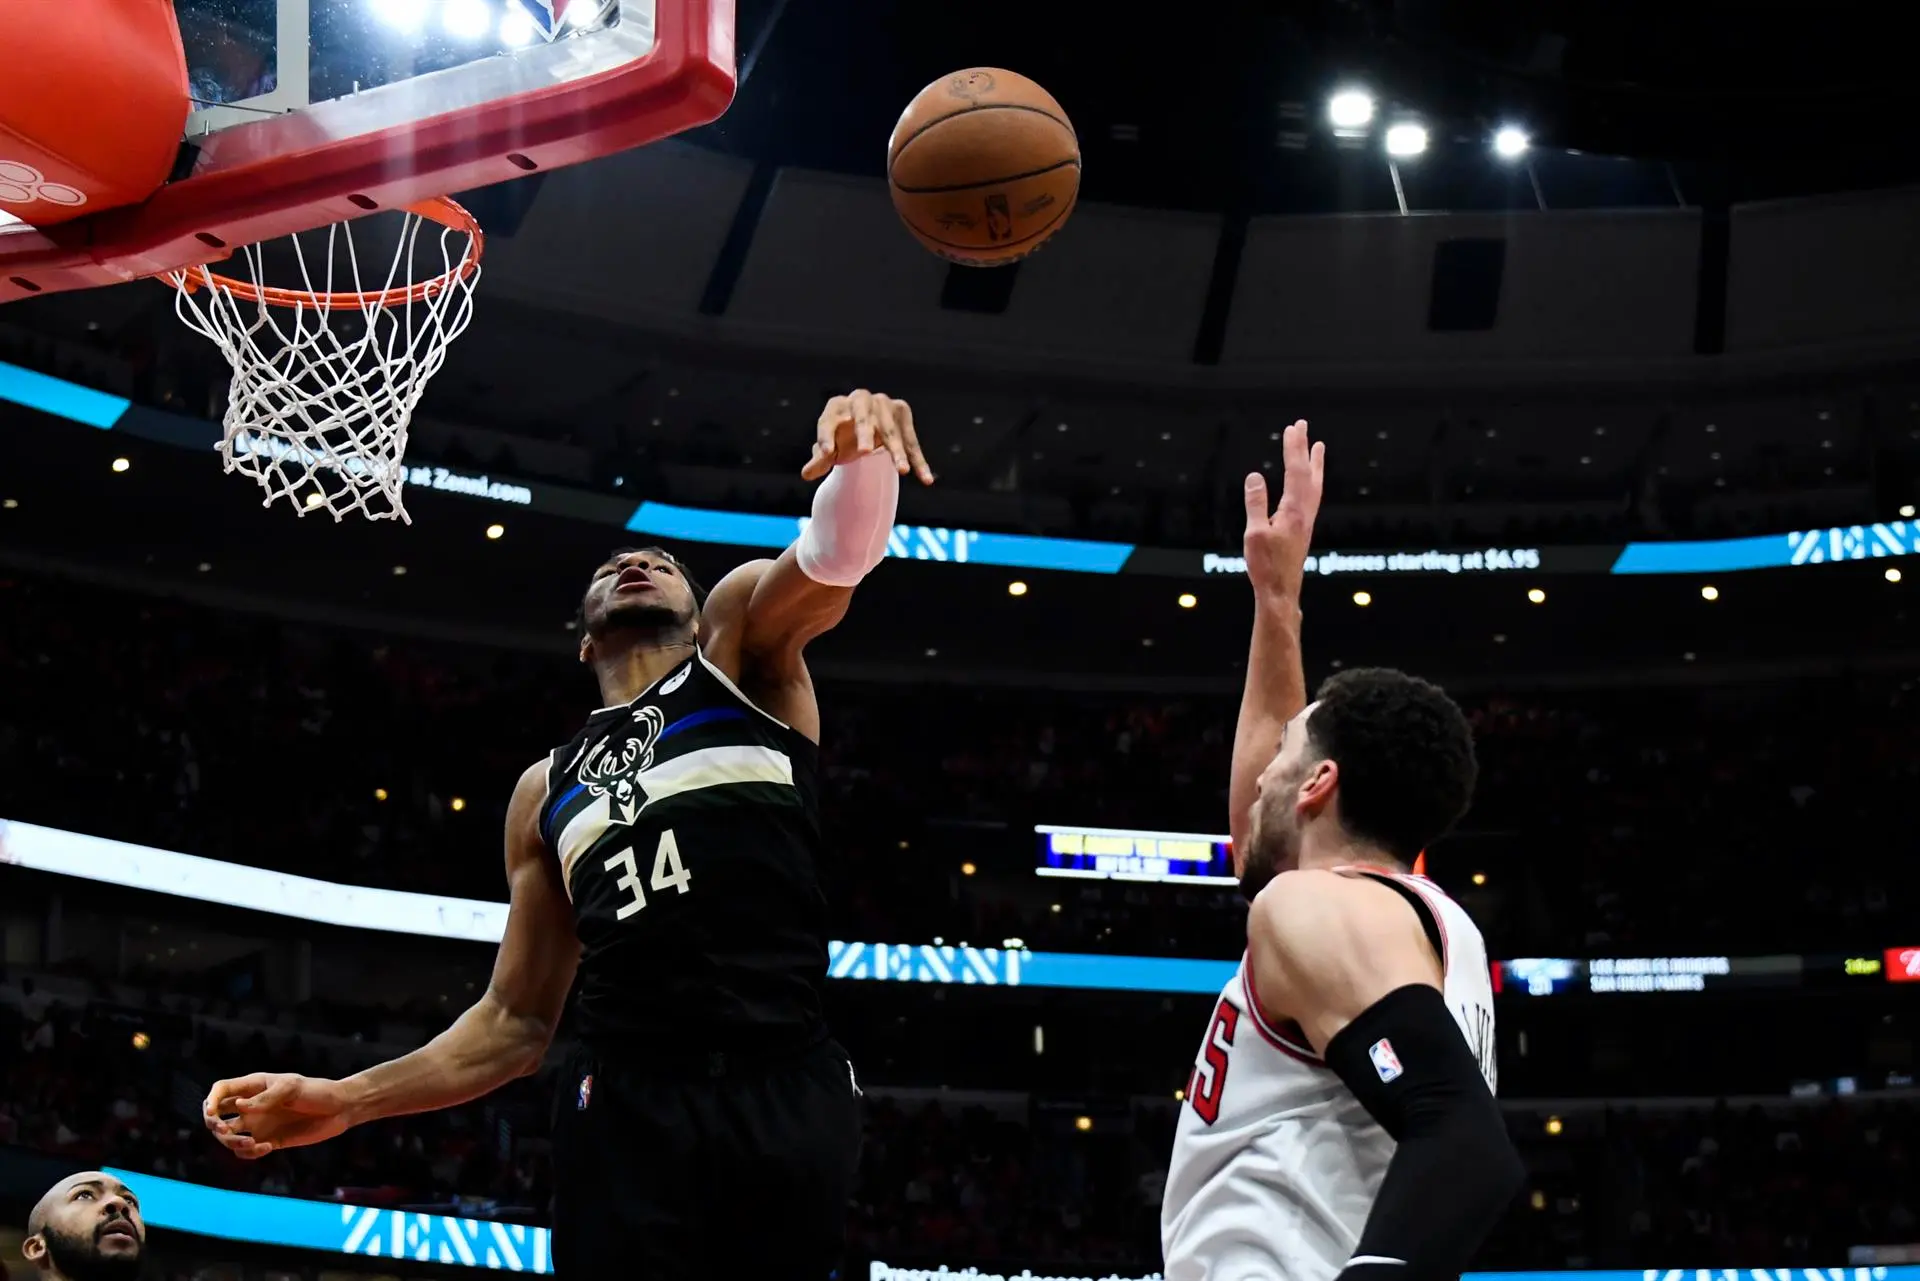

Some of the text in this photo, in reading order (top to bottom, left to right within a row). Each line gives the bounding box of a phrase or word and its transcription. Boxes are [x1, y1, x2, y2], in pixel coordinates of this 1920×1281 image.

[799, 516, 968, 562] NNI
[1788, 520, 1920, 565] ZEN
[604, 829, 692, 920] 34
[829, 940, 1020, 986] ZENNI
[1186, 998, 1240, 1126] S
[341, 1204, 547, 1274] ZENNI
